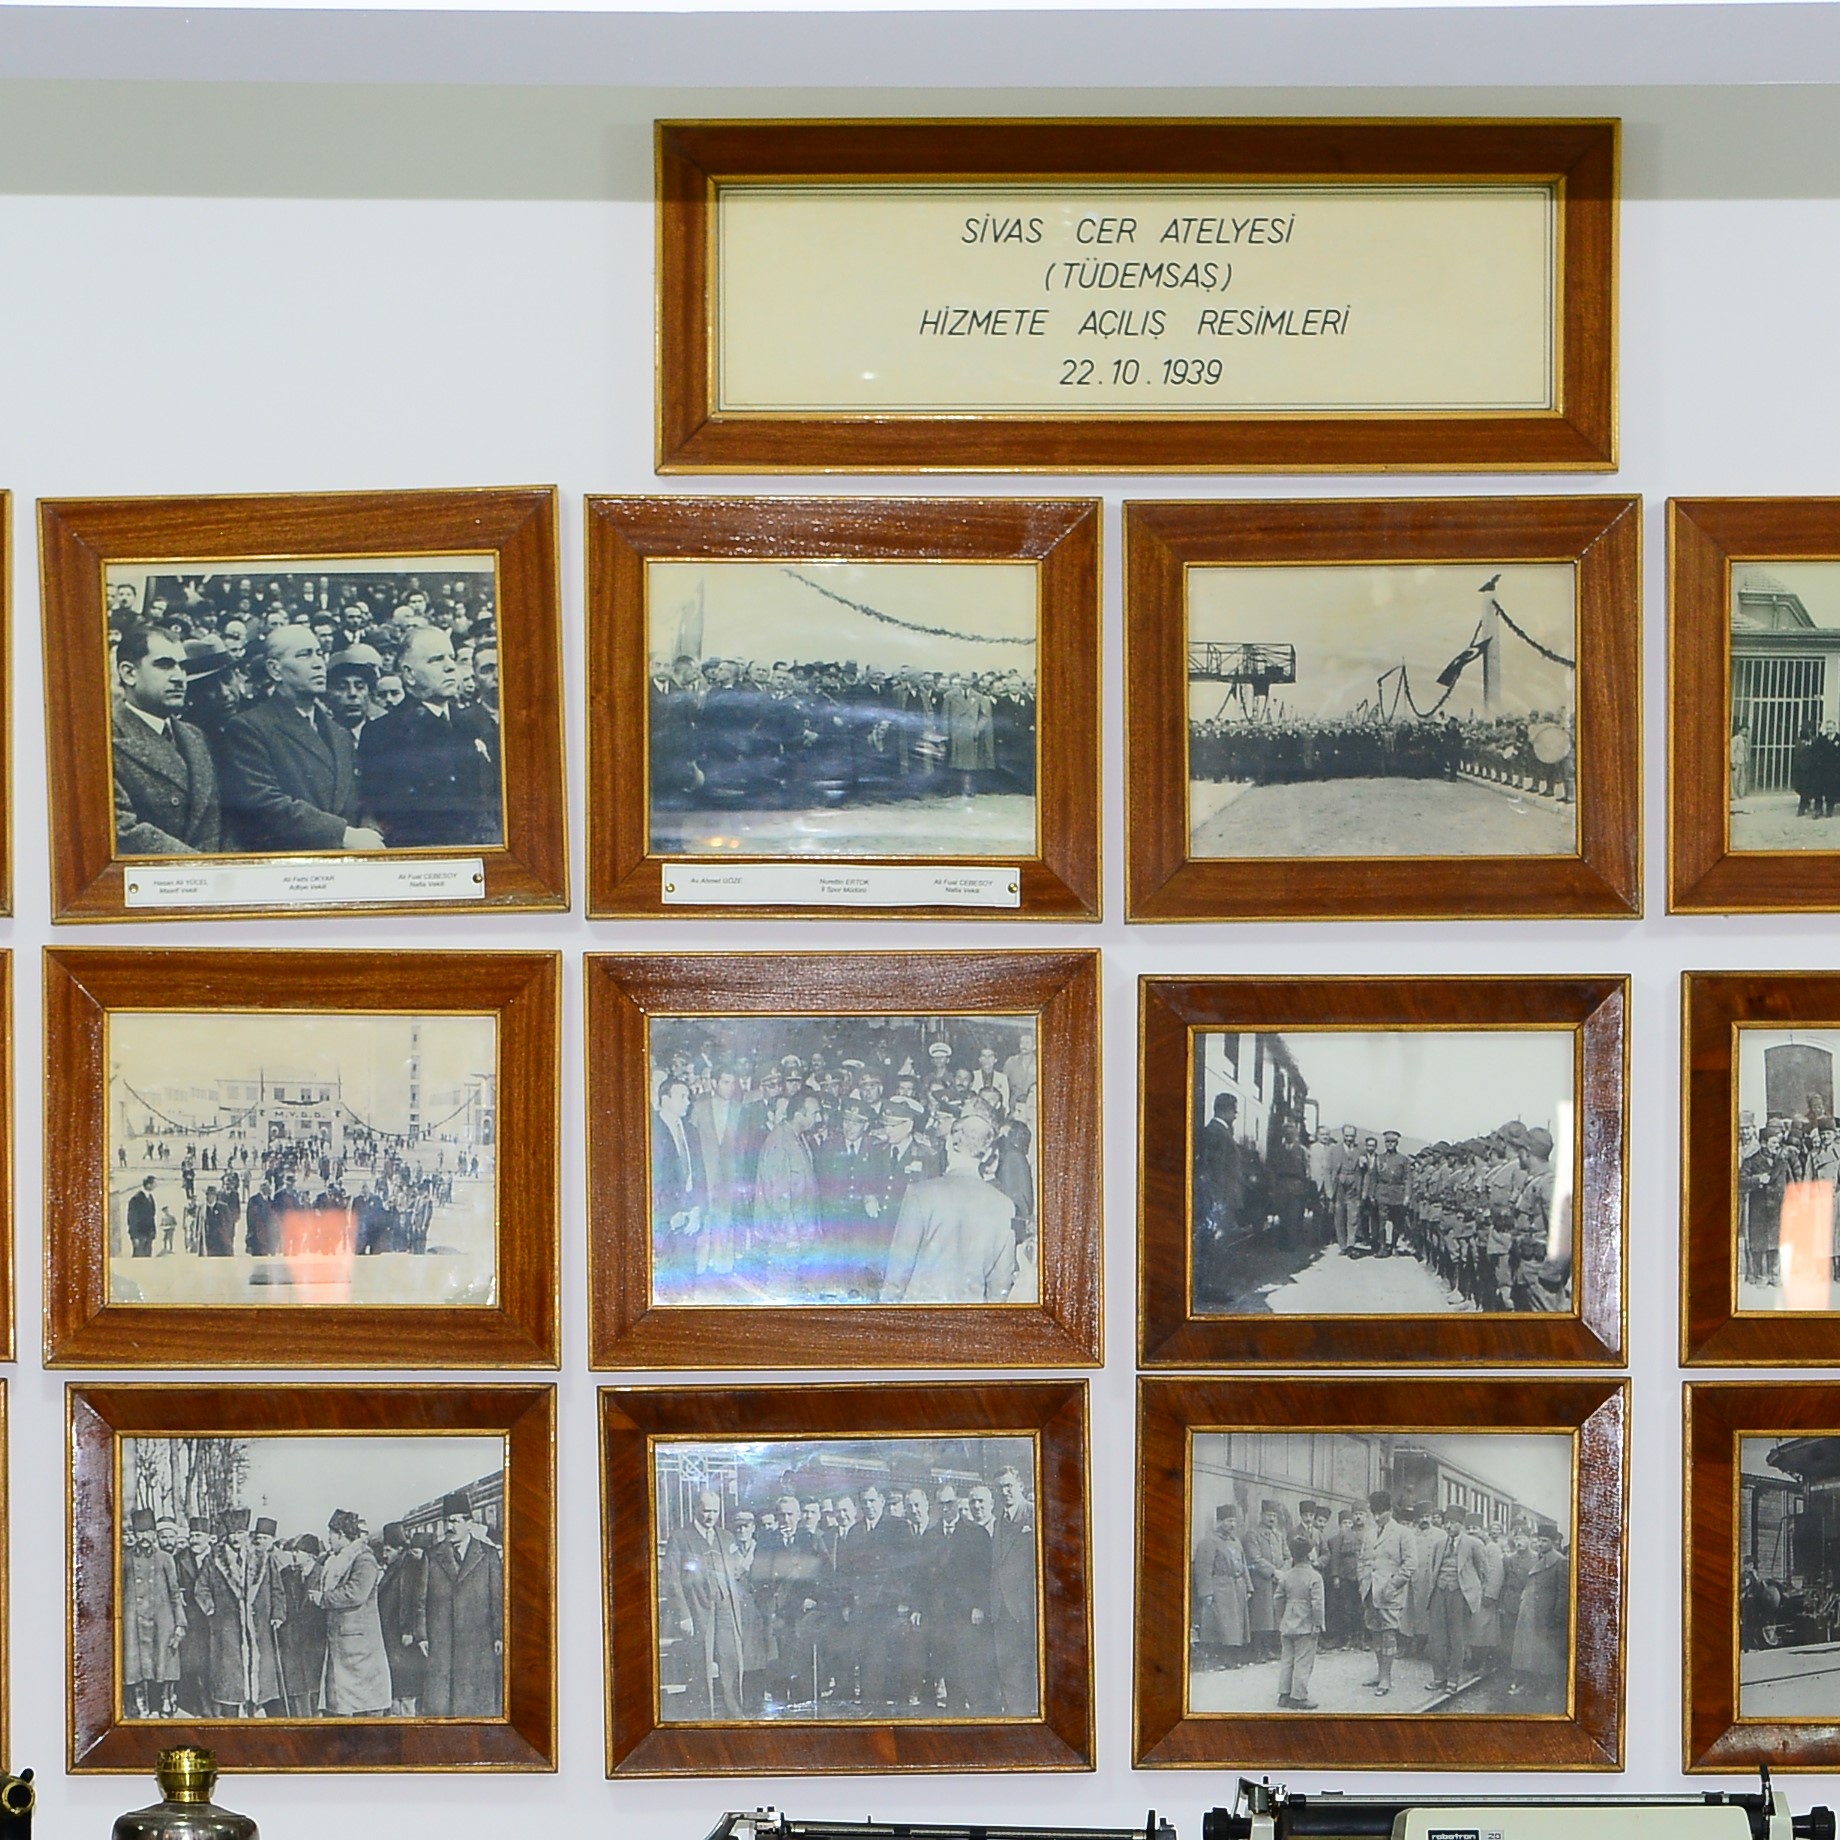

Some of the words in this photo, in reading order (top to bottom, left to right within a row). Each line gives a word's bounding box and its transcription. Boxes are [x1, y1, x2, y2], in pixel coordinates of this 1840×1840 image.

[961, 213, 1045, 244] SİVAS
[1076, 217, 1138, 244] CER
[1159, 213, 1296, 244] ATELYESİ
[1045, 257, 1233, 292] (TÜDEMSAŞ)
[919, 305, 1051, 337] HİZMETE
[1077, 309, 1168, 340] AÇILIŞ
[1197, 305, 1352, 337] RESİMLERİ
[1059, 358, 1225, 386] 22.10.1939
